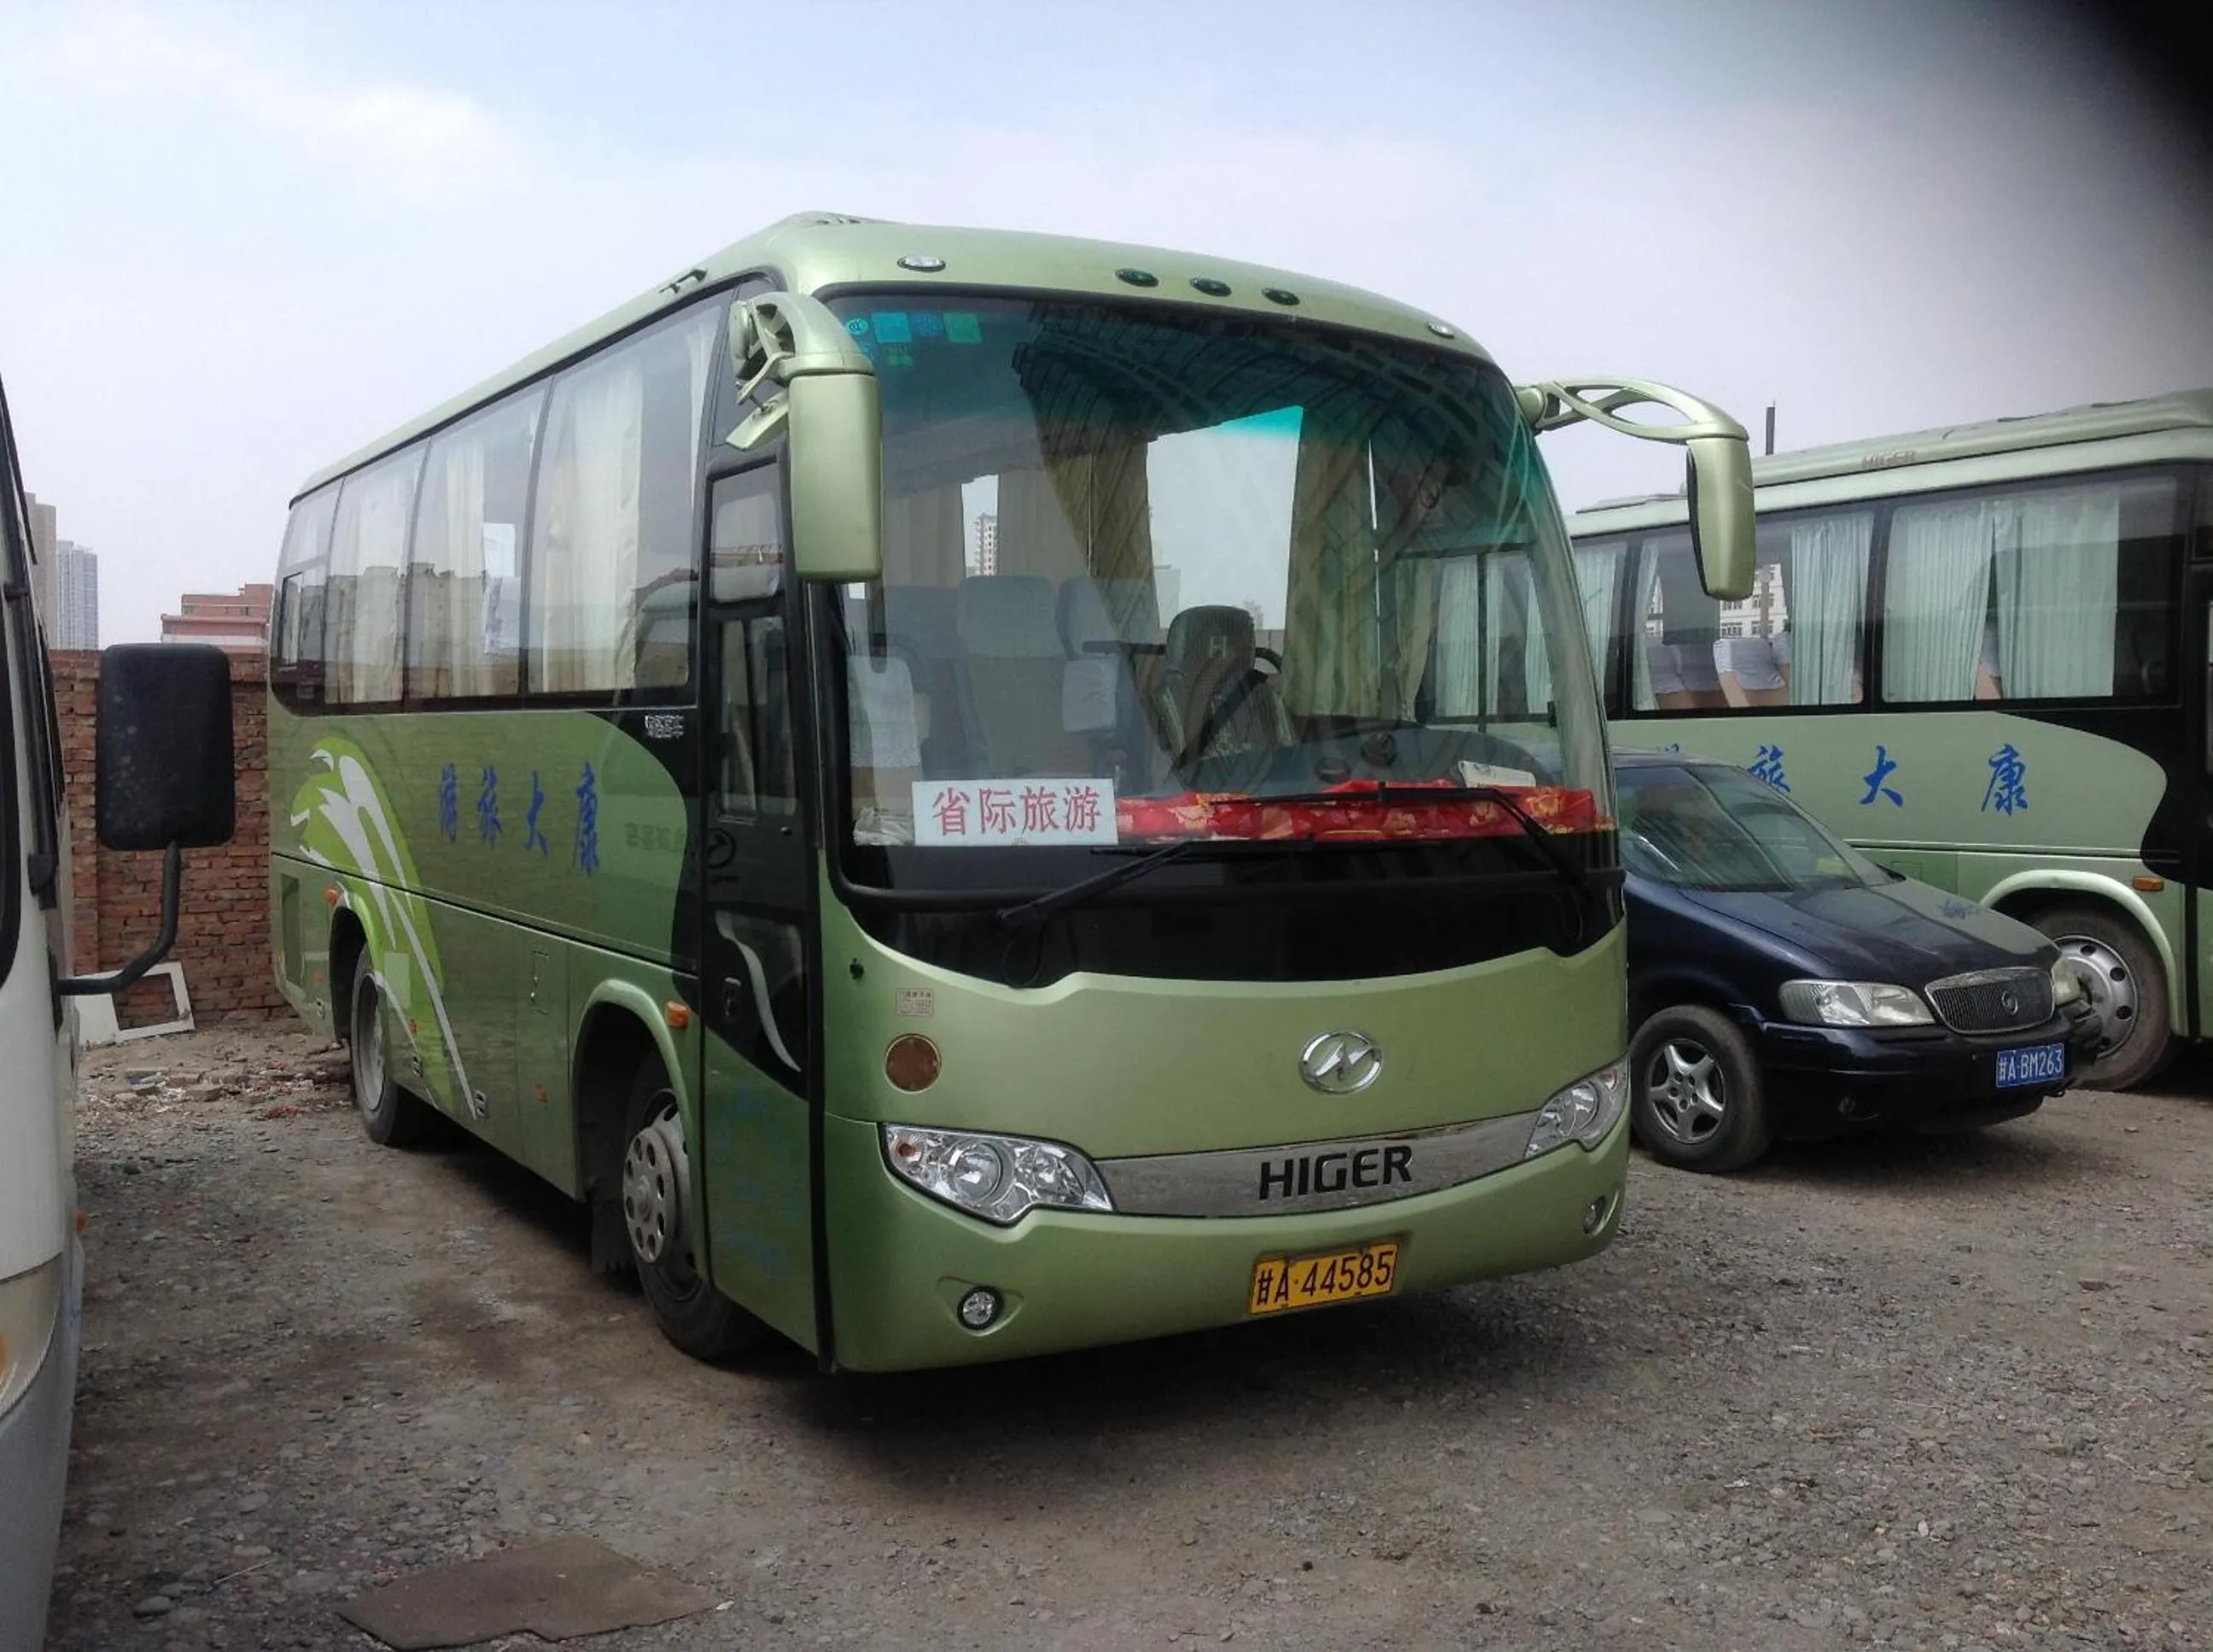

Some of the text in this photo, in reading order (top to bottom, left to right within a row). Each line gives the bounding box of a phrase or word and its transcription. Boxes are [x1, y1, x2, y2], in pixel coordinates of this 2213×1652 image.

[932, 785, 1101, 836] 省际旅游
[1259, 1146, 1413, 1200] HIGER
